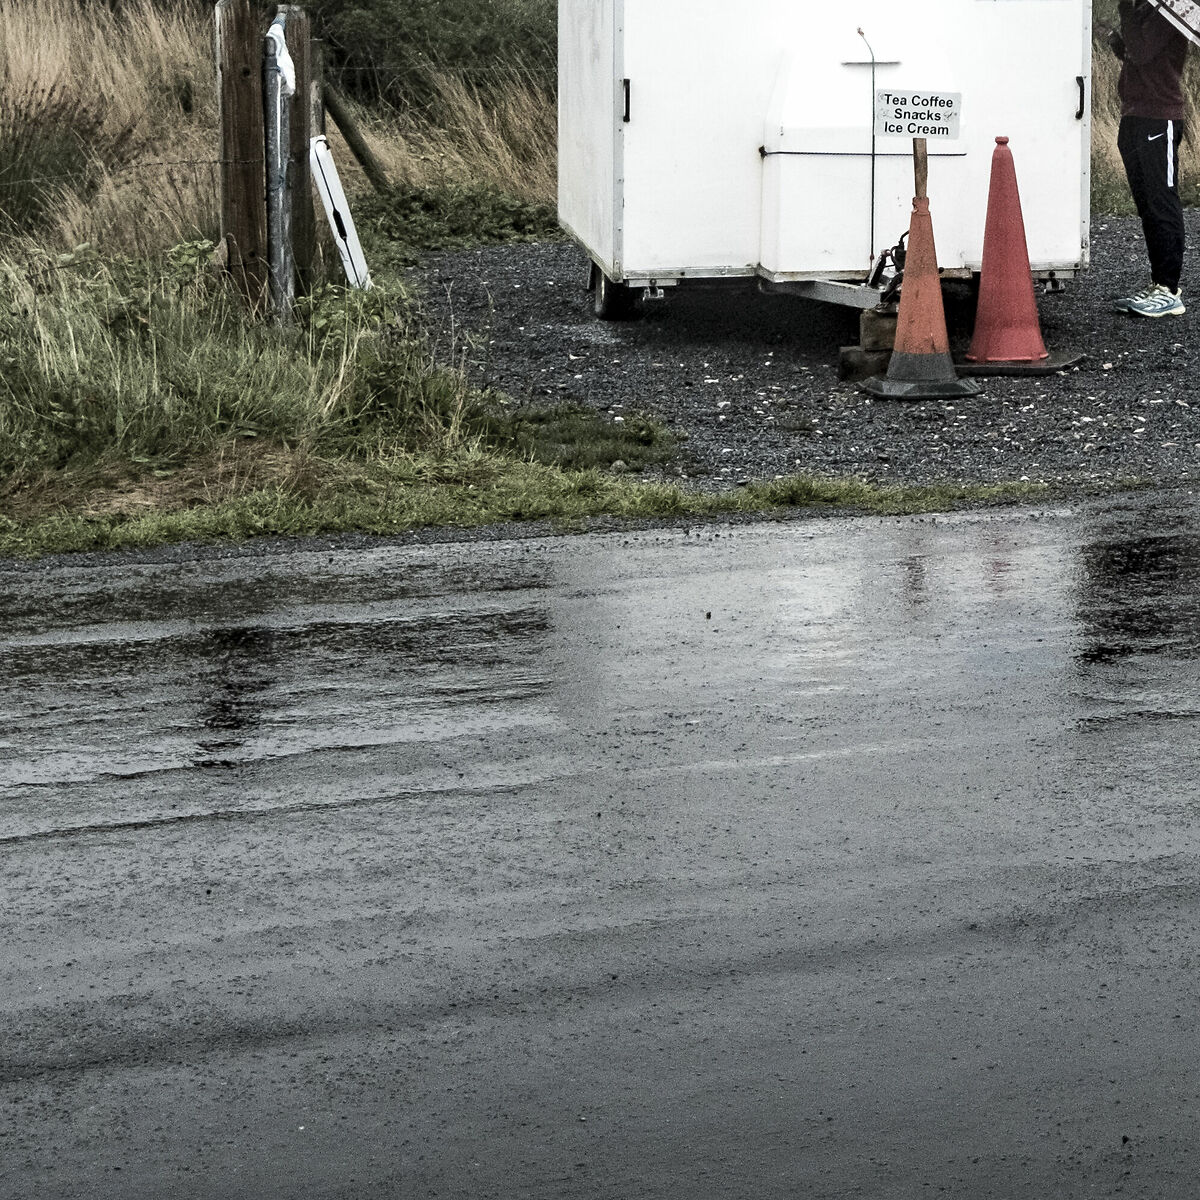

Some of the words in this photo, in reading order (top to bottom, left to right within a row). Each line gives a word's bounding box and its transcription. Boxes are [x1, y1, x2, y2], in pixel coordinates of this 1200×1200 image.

[884, 93, 907, 105] Tea
[911, 95, 953, 108] Coffee
[894, 108, 941, 120] Snacks
[884, 121, 903, 133] Ice
[907, 122, 949, 135] Cream
